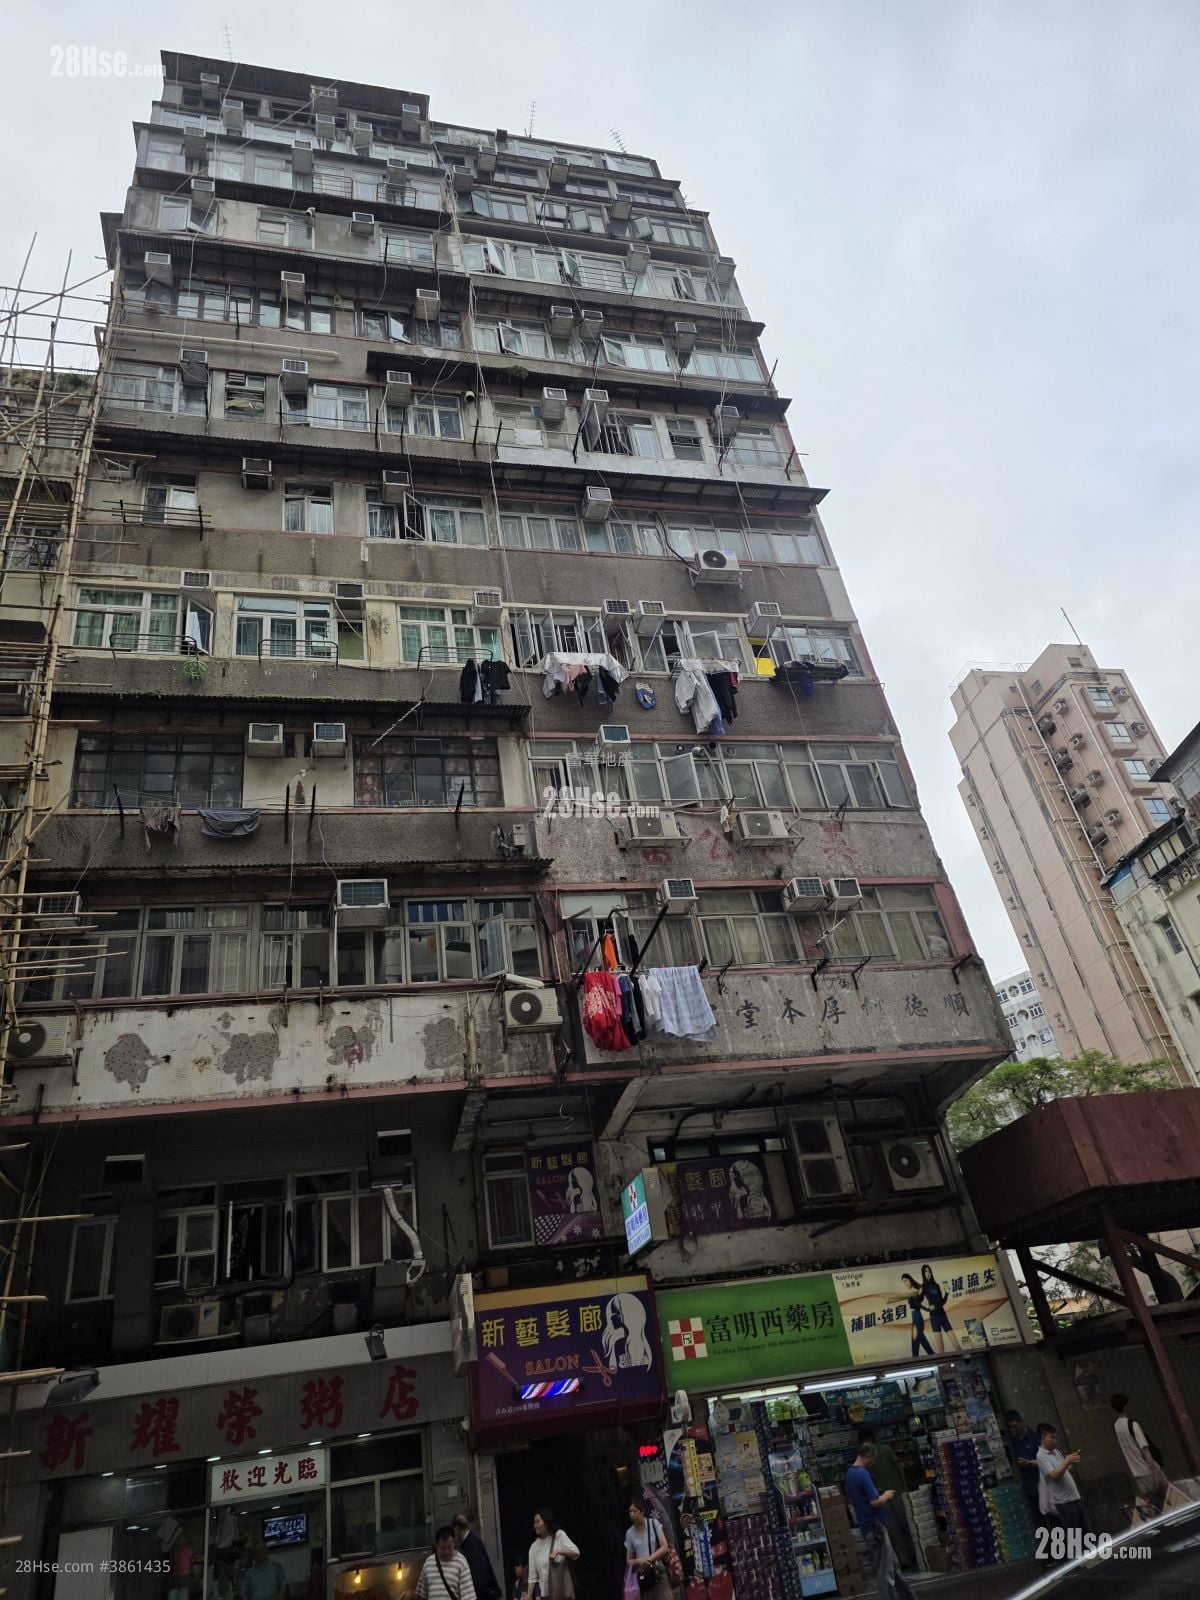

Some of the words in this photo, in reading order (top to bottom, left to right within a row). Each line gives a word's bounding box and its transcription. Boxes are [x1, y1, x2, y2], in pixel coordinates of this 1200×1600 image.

[481, 1304, 603, 1348] 新藝髮廊
[706, 1301, 834, 1344] 富明西藥房
[524, 1353, 581, 1376] SALON
[38, 1364, 421, 1471] 新耀榮粥店
[219, 1456, 319, 1494] 歡迎光臨
